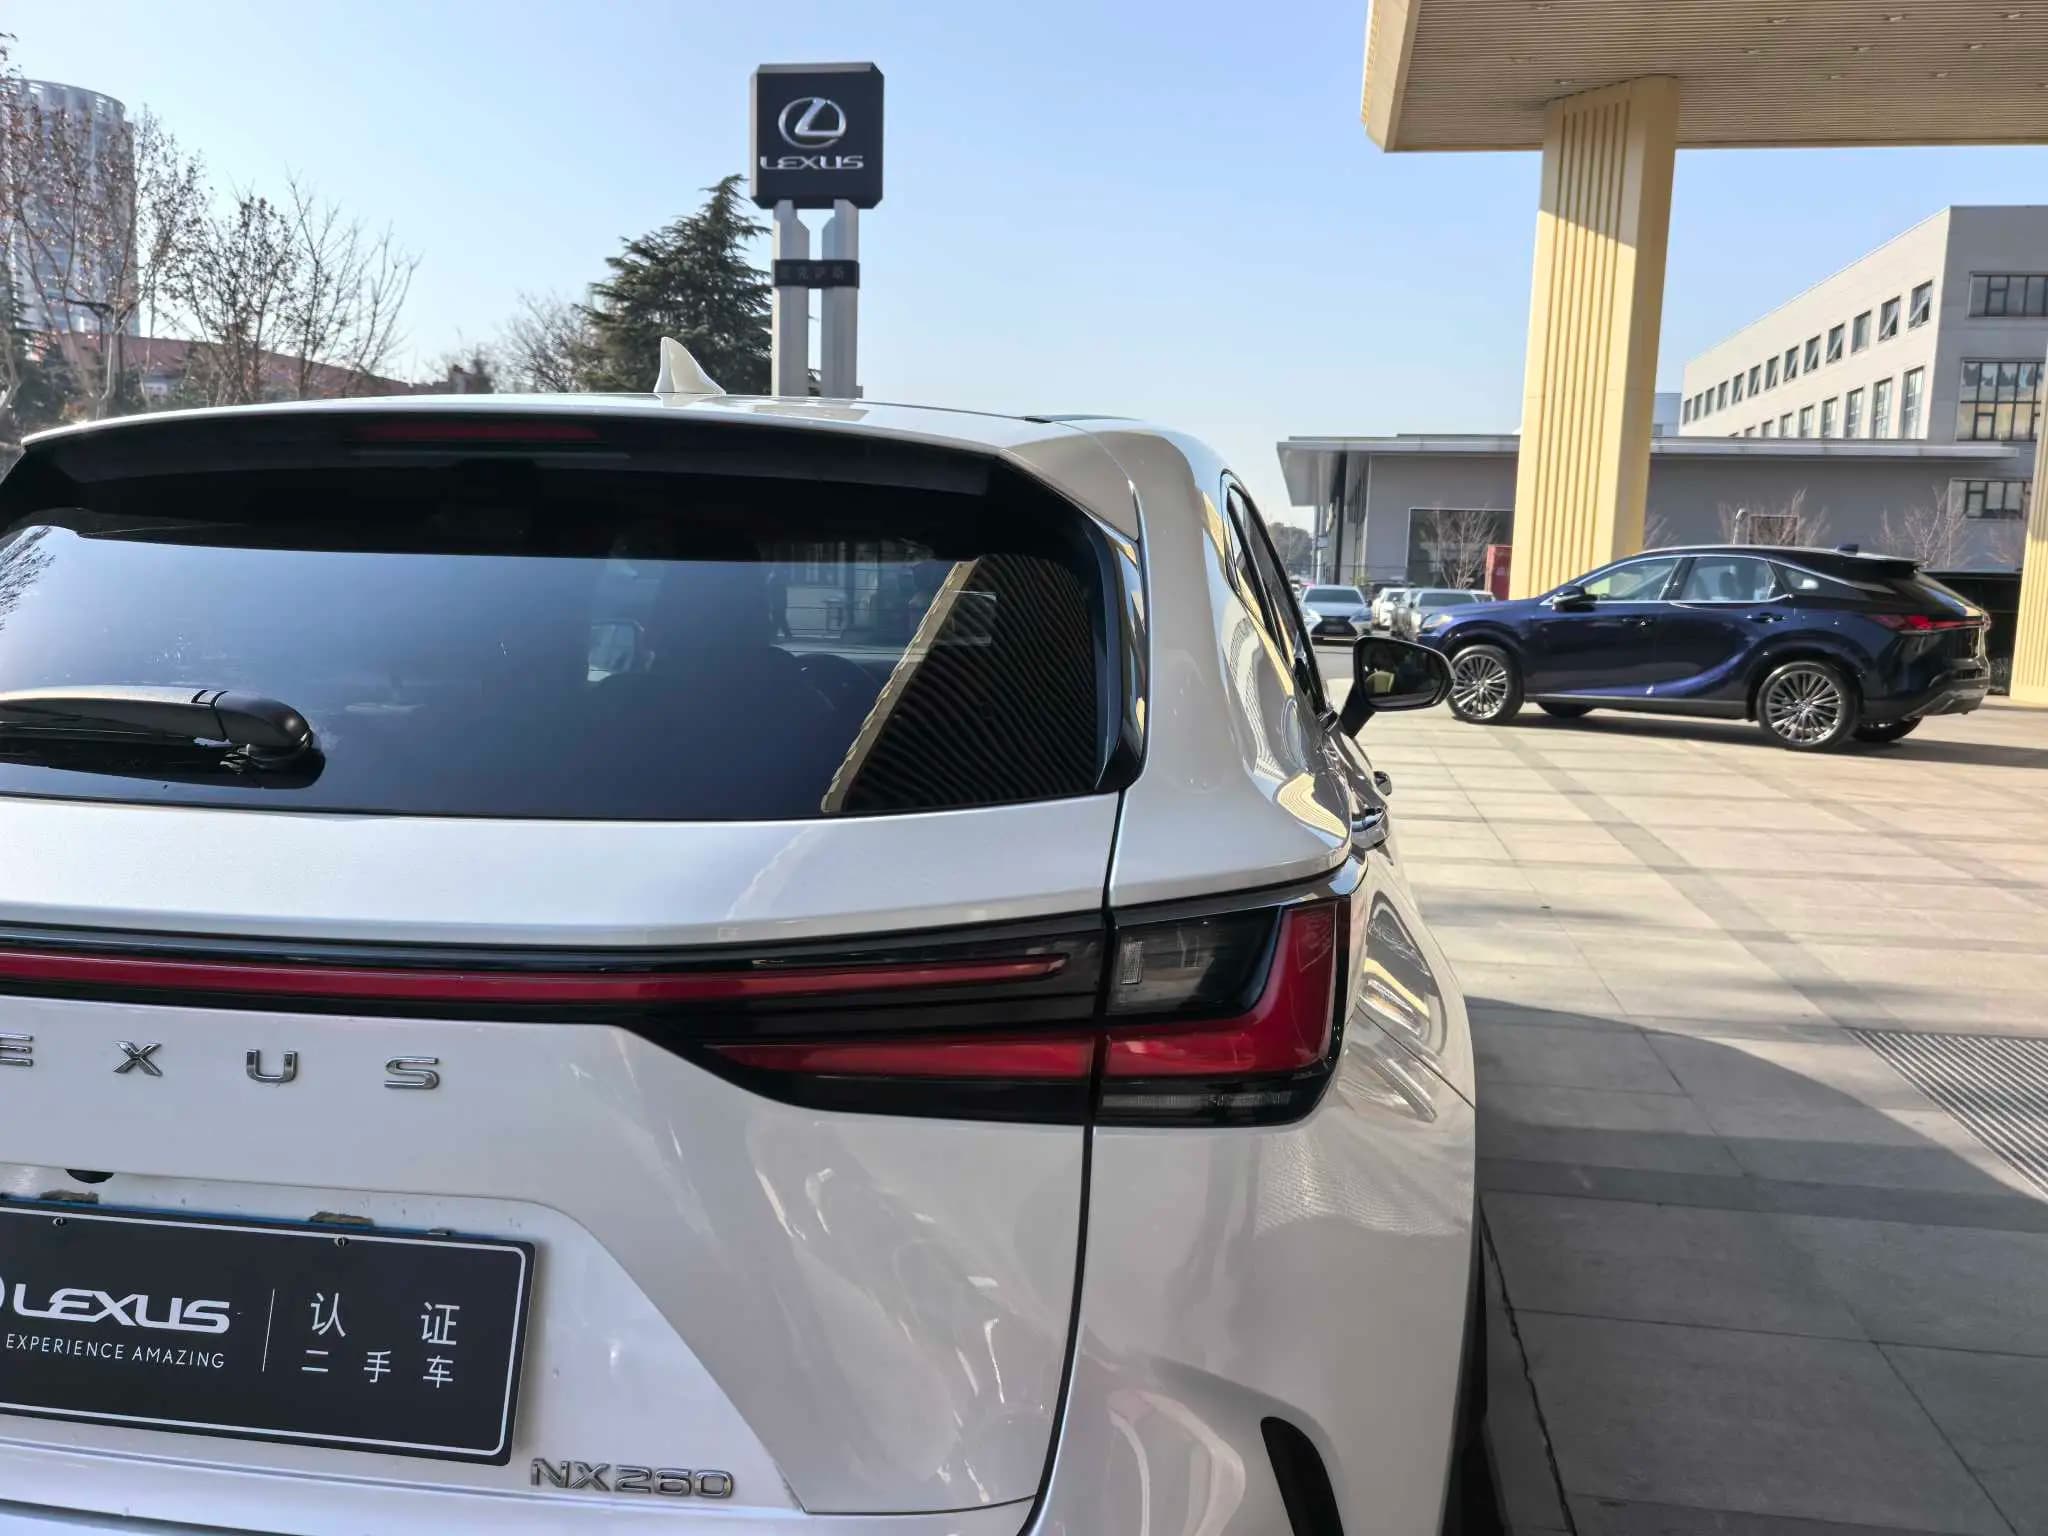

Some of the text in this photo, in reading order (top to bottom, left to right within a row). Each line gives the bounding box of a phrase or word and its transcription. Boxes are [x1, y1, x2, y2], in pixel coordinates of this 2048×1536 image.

[760, 154, 864, 170] LEXUS
[0, 1032, 441, 1090] EXUS
[13, 1283, 230, 1334] LEXUS
[310, 1293, 460, 1346] 认证
[6, 1333, 225, 1369] EXPERIENCE AMAZING
[301, 1350, 454, 1388] 二手车
[531, 1457, 735, 1499] NX260
